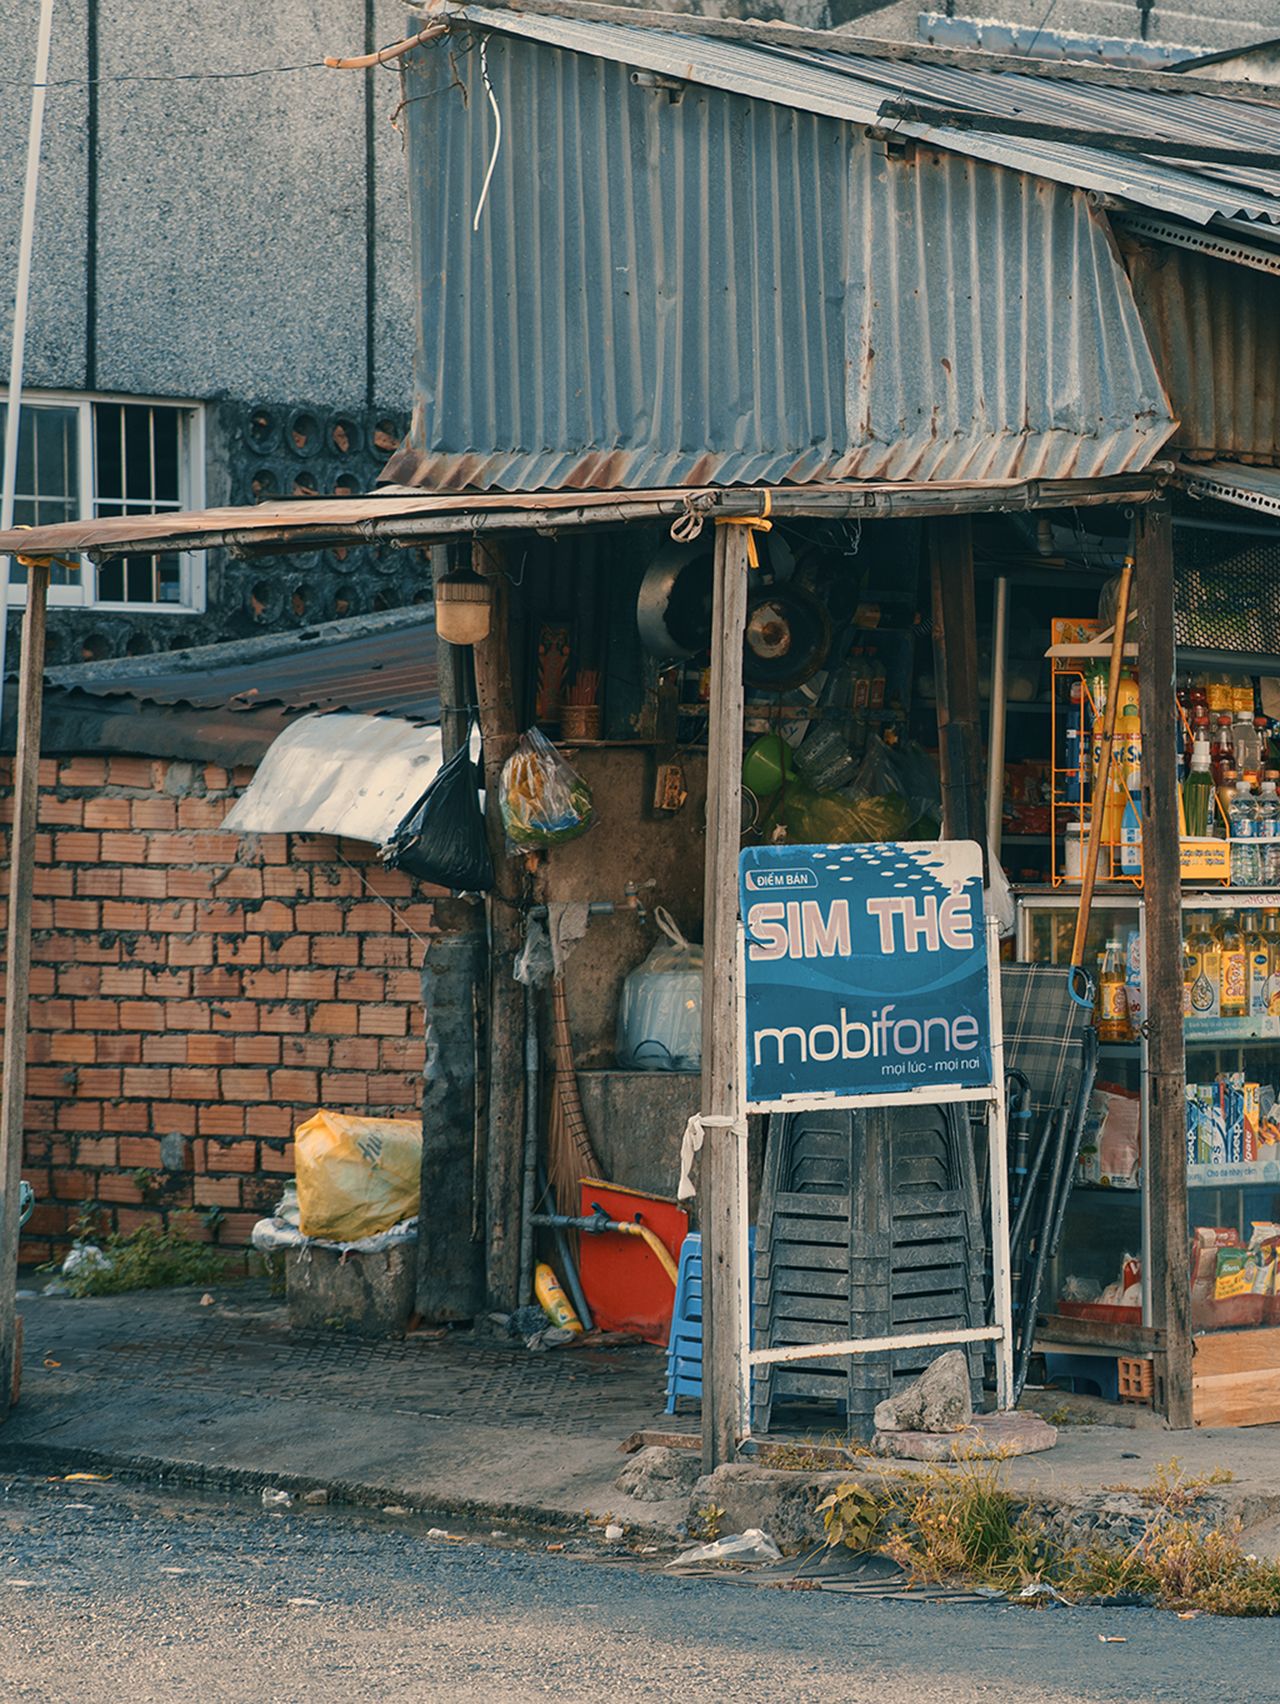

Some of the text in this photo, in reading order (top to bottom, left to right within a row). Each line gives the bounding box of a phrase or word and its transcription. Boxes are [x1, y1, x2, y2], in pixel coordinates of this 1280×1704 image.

[786, 871, 808, 885] BÁN
[748, 880, 974, 961] SIM THẺ
[754, 1004, 979, 1066] mobifone
[881, 1062, 906, 1076] mọi
[907, 1060, 927, 1073] lúc
[934, 1057, 959, 1072] mọi
[960, 1056, 980, 1069] nơi
